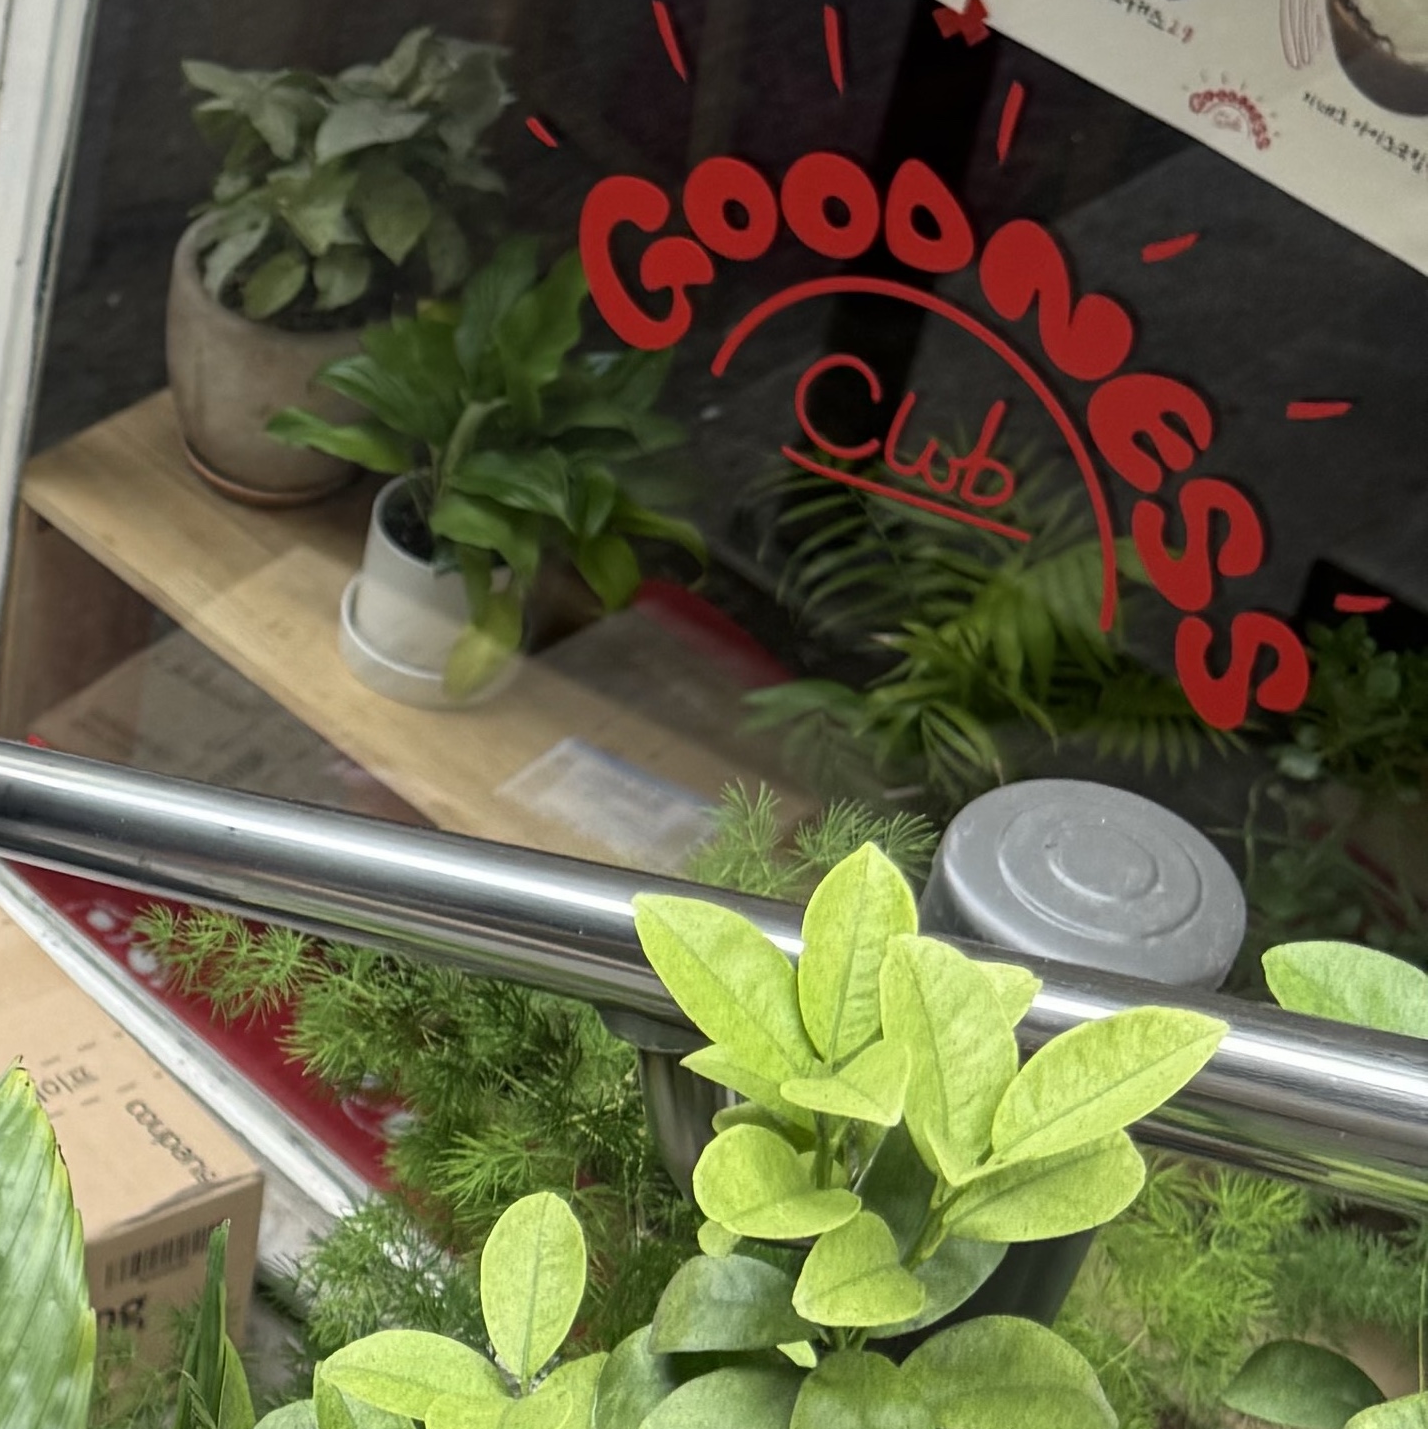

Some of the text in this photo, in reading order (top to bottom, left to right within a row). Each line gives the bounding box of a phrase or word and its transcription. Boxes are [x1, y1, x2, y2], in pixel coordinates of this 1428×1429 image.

[578, 151, 1310, 732] GOODNESS
[794, 353, 1017, 508] Club
[35, 1065, 99, 1104] 이프
